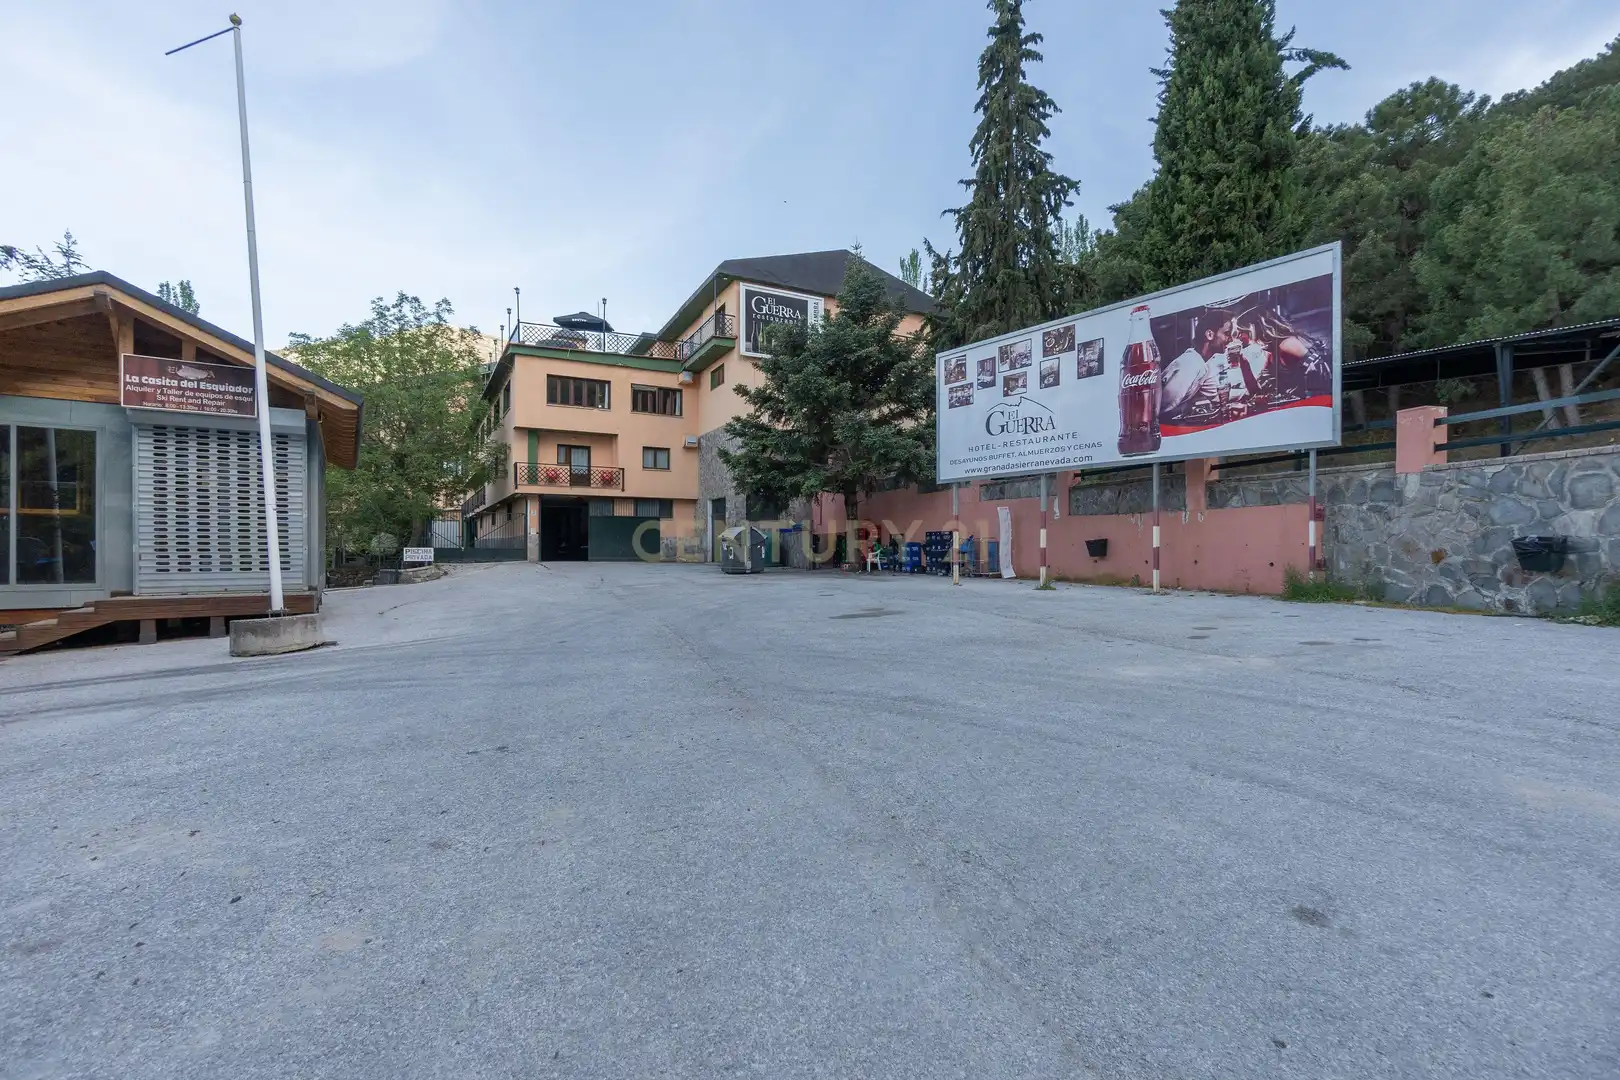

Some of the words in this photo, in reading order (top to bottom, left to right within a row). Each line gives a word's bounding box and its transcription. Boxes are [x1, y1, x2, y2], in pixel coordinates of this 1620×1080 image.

[751, 295, 801, 319] GUERRA
[126, 374, 140, 383] La
[180, 380, 198, 389] del
[200, 382, 253, 394] Esquiador
[126, 384, 155, 393] Alquiler
[195, 392, 223, 400] equipos
[170, 395, 187, 403] Rent
[188, 397, 201, 405] and
[203, 398, 226, 407] Repair
[985, 410, 1056, 436] GUERRA
[949, 455, 988, 466] DESAYUNOS
[1017, 445, 1067, 457] ALMUERZOS
[1073, 441, 1103, 451] CENAS
[964, 455, 1093, 474] www.granadasierranevada.com
